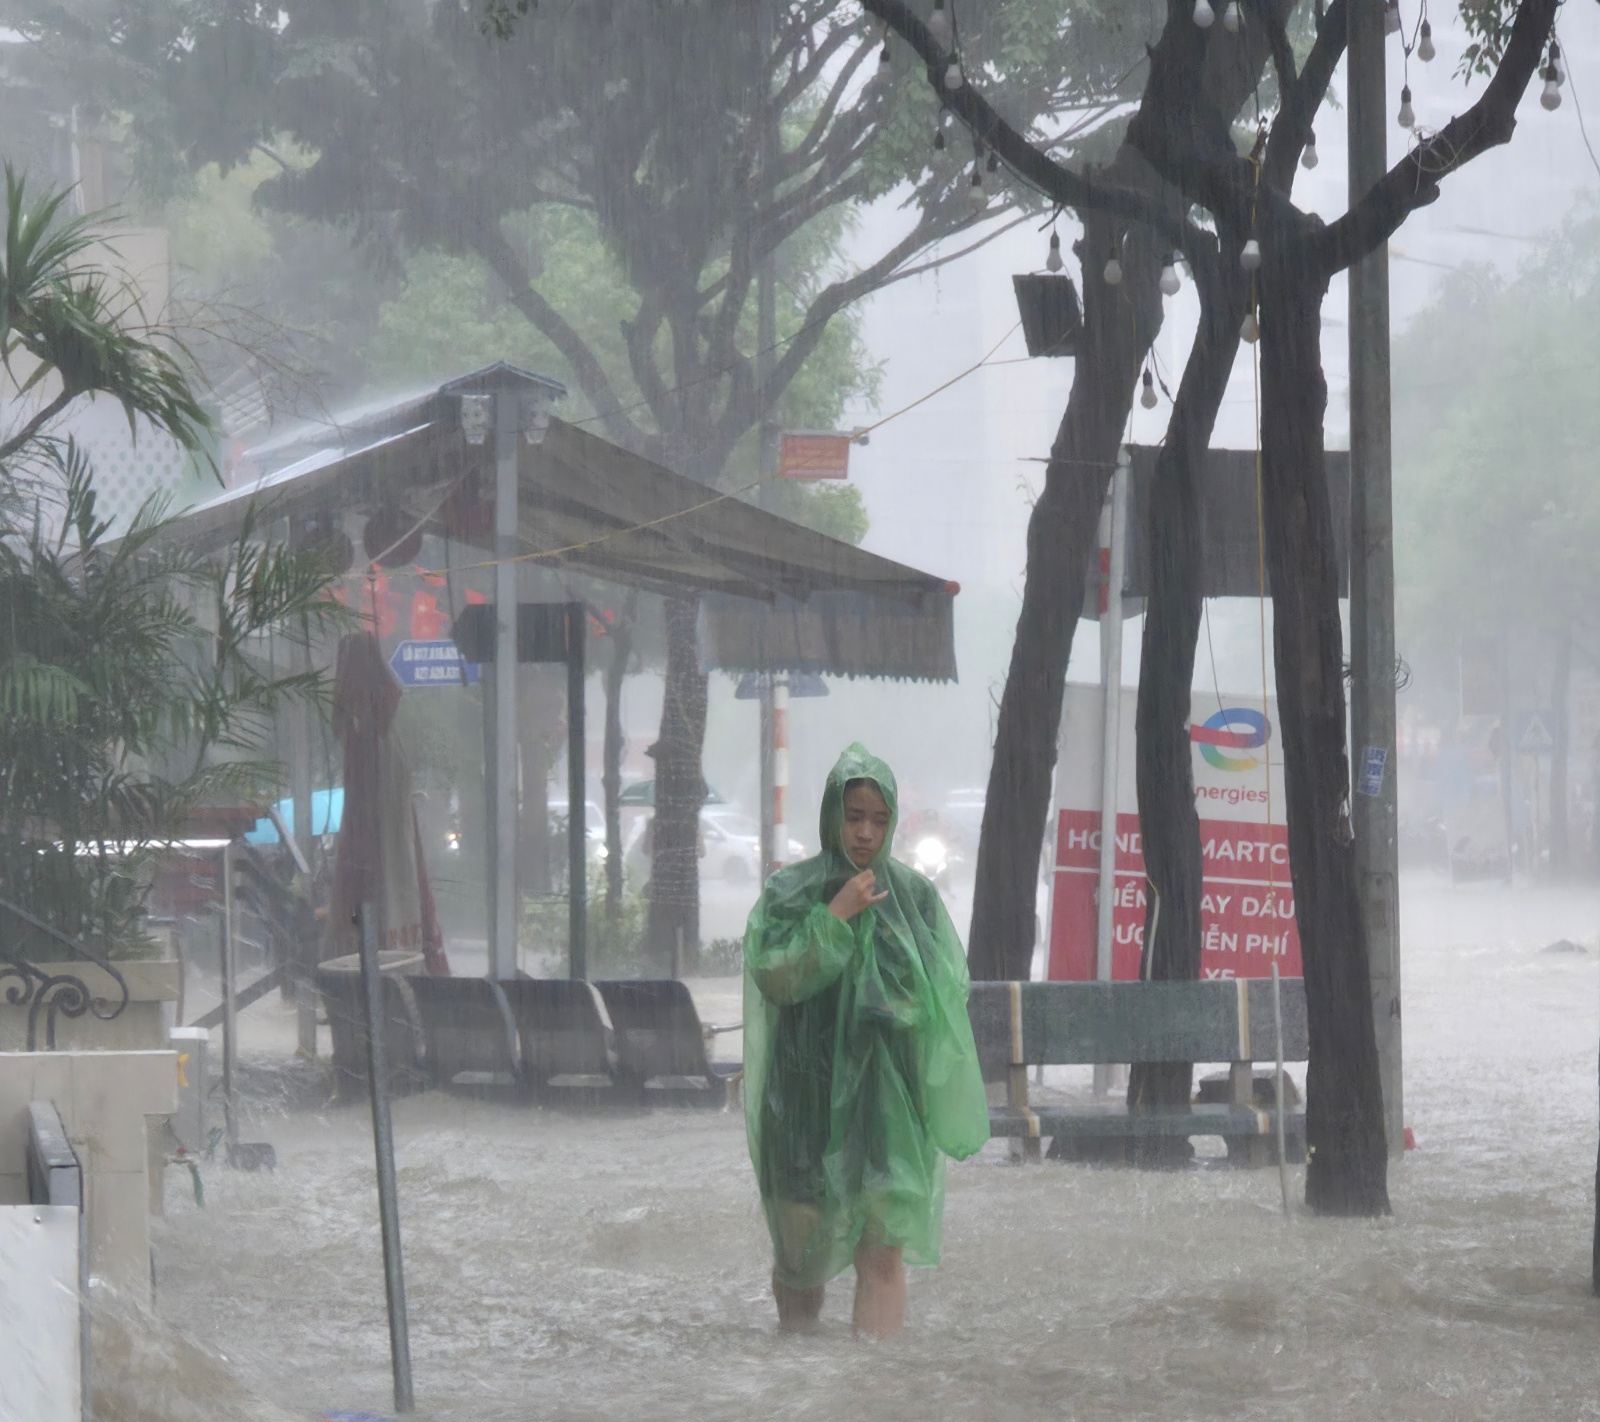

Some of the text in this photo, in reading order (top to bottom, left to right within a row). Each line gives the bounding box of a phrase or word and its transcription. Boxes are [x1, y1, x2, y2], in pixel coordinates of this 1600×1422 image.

[1195, 786, 1269, 805] nergies
[1068, 828, 1288, 864] HOND MARTC
[1200, 894, 1231, 914] AY
[1200, 924, 1238, 952] IỄN
[1246, 931, 1288, 955] PHÍ
